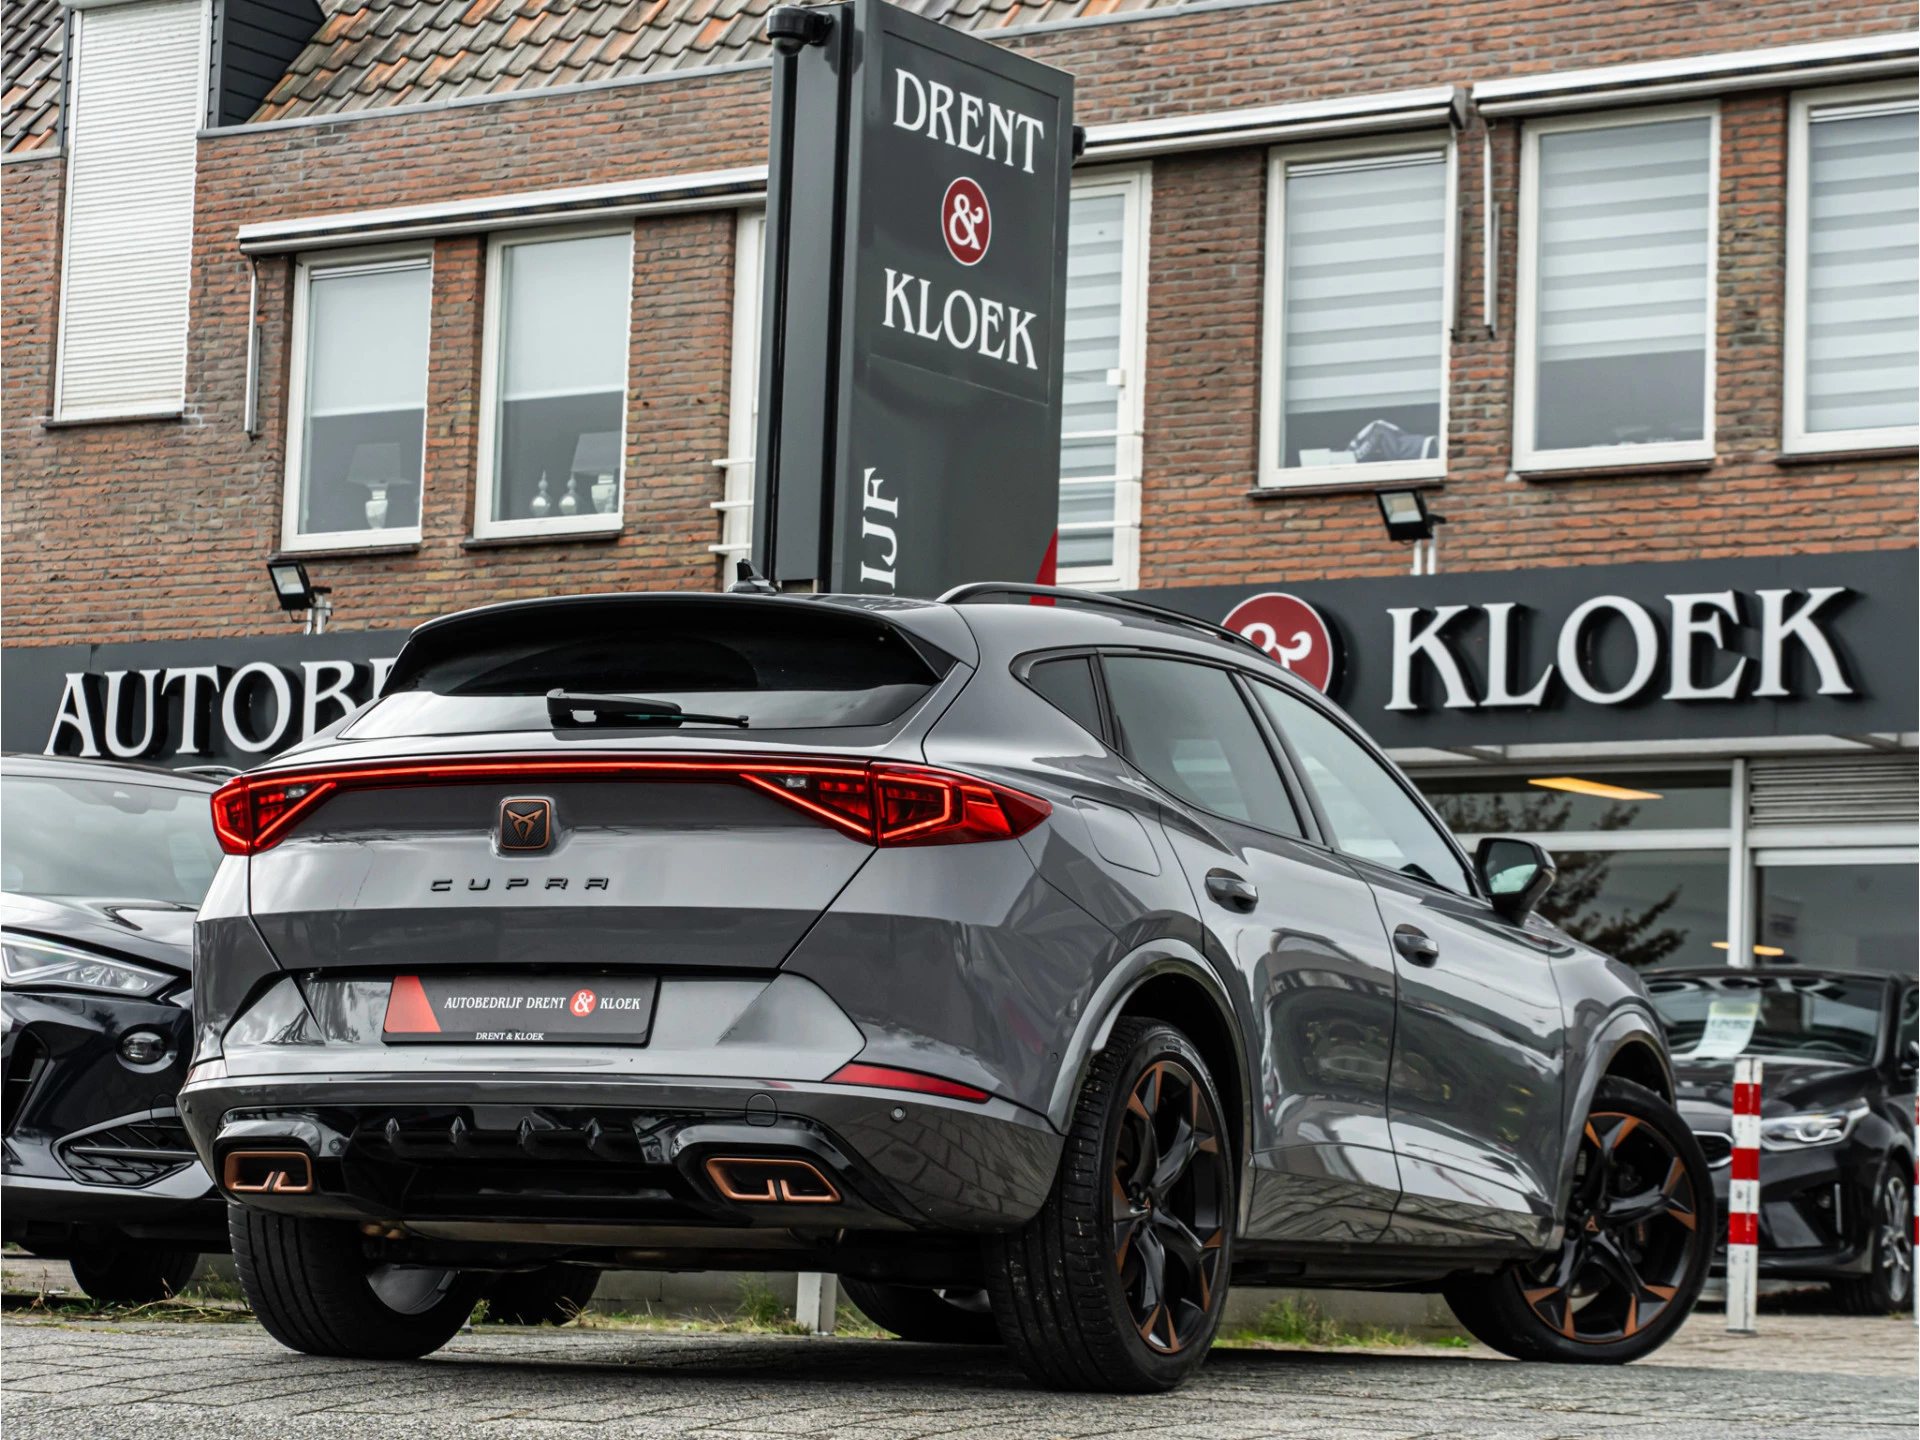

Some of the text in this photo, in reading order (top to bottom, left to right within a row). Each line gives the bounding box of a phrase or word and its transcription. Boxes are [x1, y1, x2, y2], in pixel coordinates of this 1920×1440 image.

[893, 68, 1045, 174] DRENT
[948, 193, 984, 251] &
[882, 267, 1038, 370] KLOEK
[860, 466, 899, 596] IJF
[1384, 586, 1854, 711] KLOEK
[430, 876, 609, 892] CUPRA
[443, 991, 642, 1013] AUTOBEDRIJF DRENT & KLOEK
[475, 1031, 545, 1042] DRENT & KLOEK
